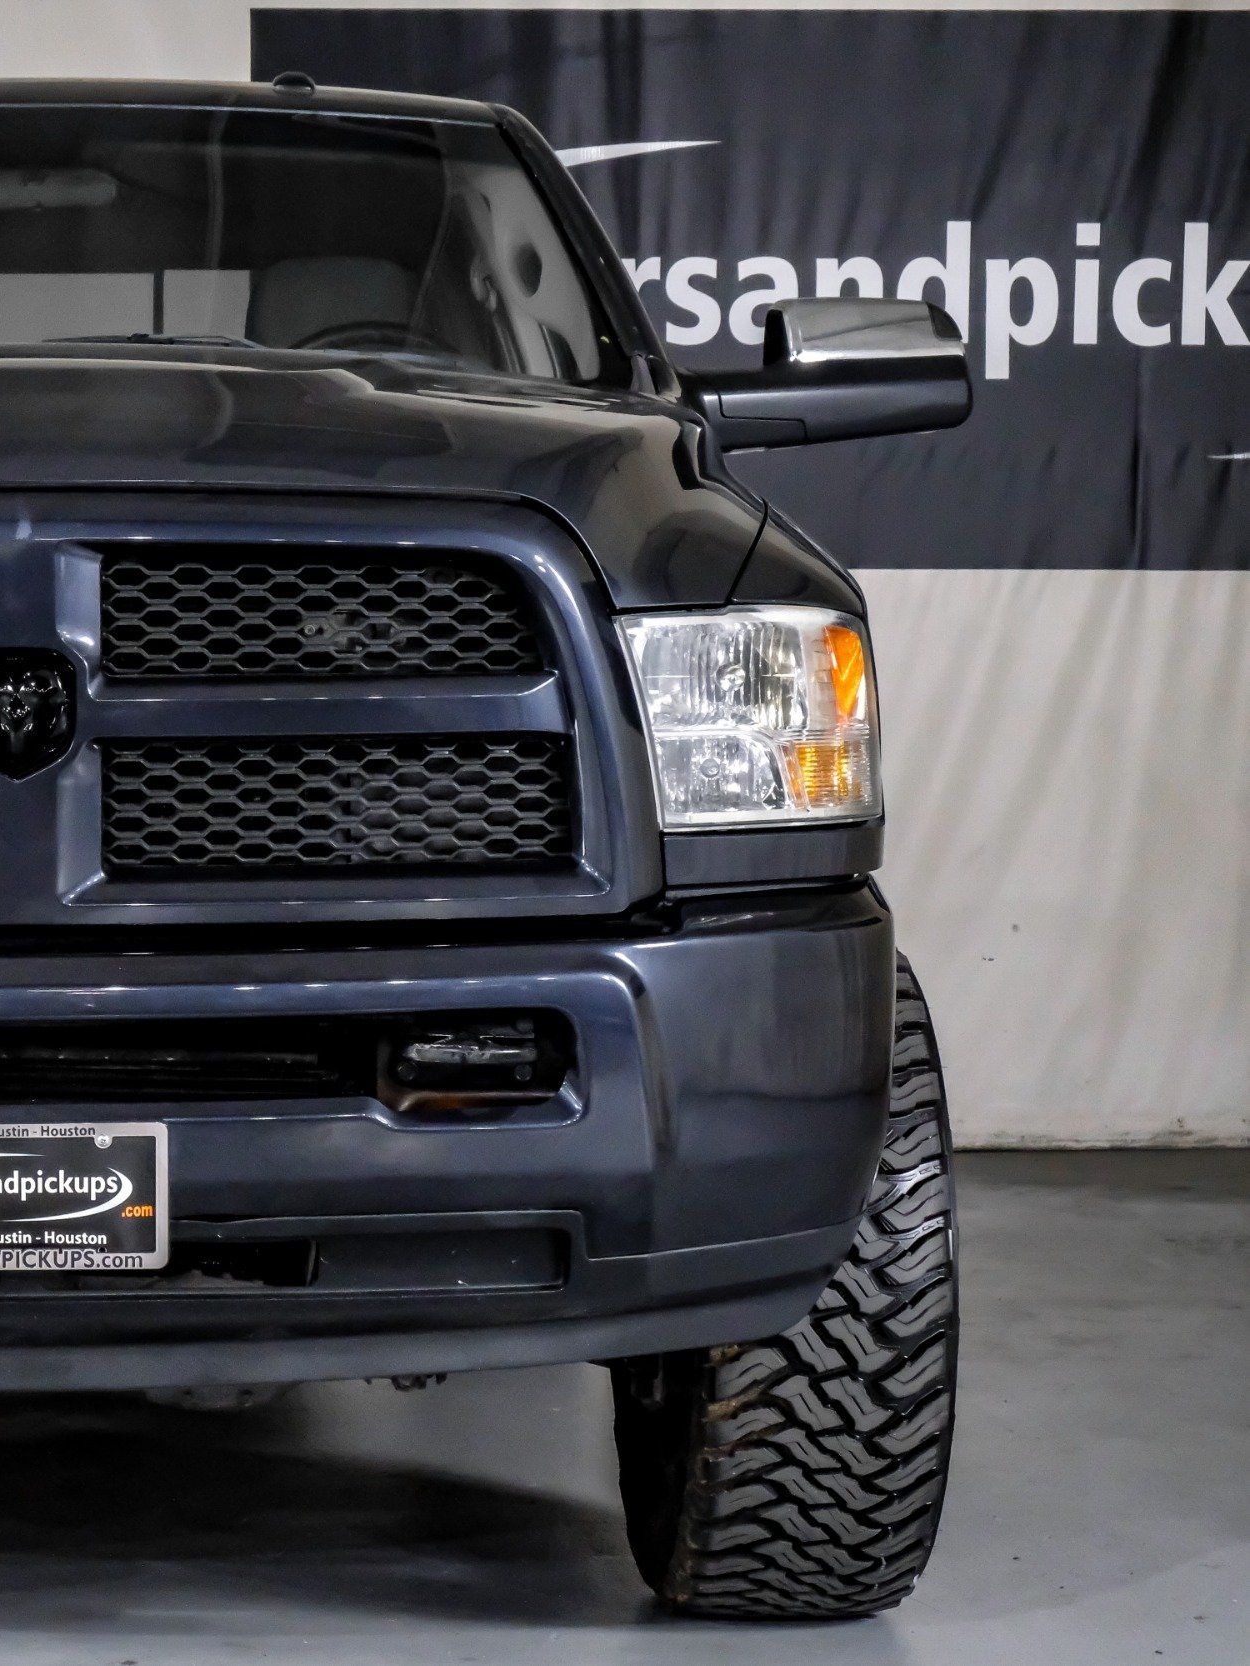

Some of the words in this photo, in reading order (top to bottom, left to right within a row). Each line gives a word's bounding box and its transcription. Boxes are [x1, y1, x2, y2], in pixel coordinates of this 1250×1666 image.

[41, 1125, 96, 1137] Houston
[121, 1203, 153, 1218] .com
[44, 1231, 107, 1245] Houston
